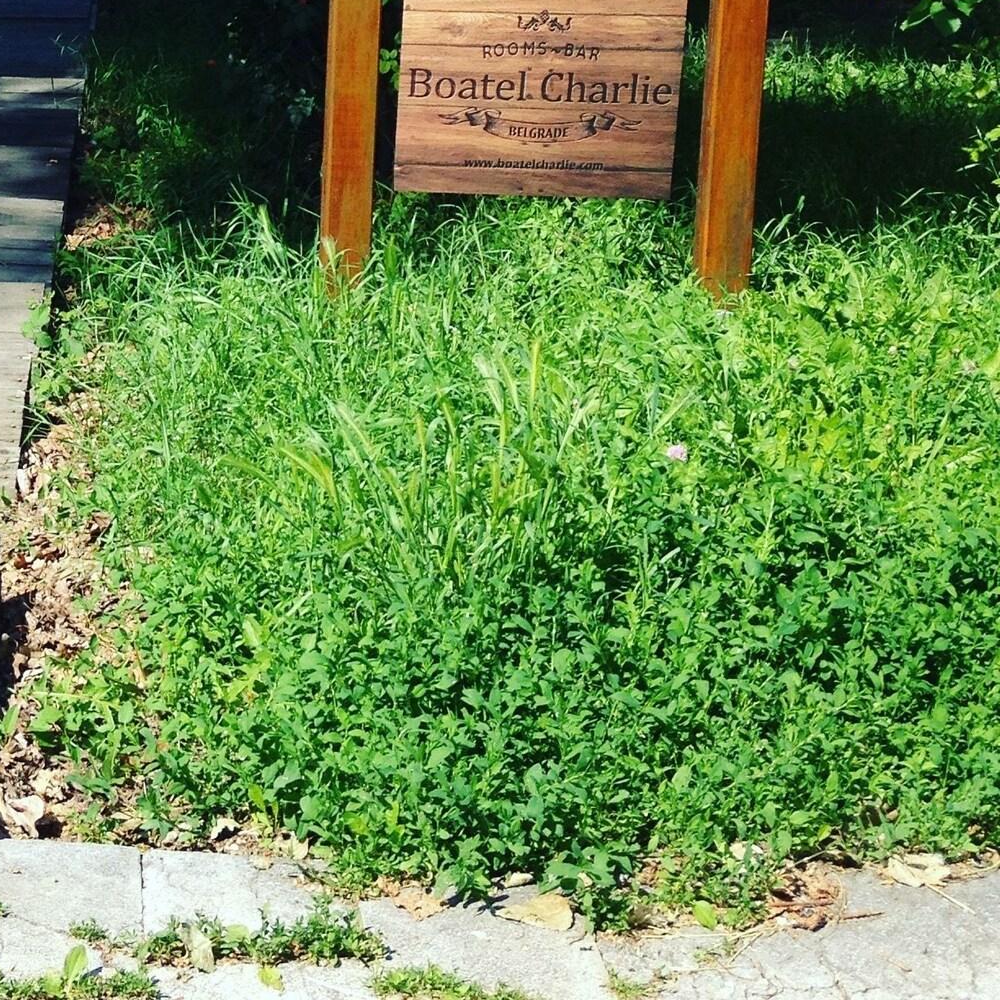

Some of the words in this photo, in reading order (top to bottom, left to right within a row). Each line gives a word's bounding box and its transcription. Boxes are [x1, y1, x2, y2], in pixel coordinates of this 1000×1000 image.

[408, 67, 527, 101] Boatel
[540, 71, 673, 105] Charlie
[508, 126, 568, 139] BELGRADE
[463, 157, 604, 171] www.boatelcharlie.com
